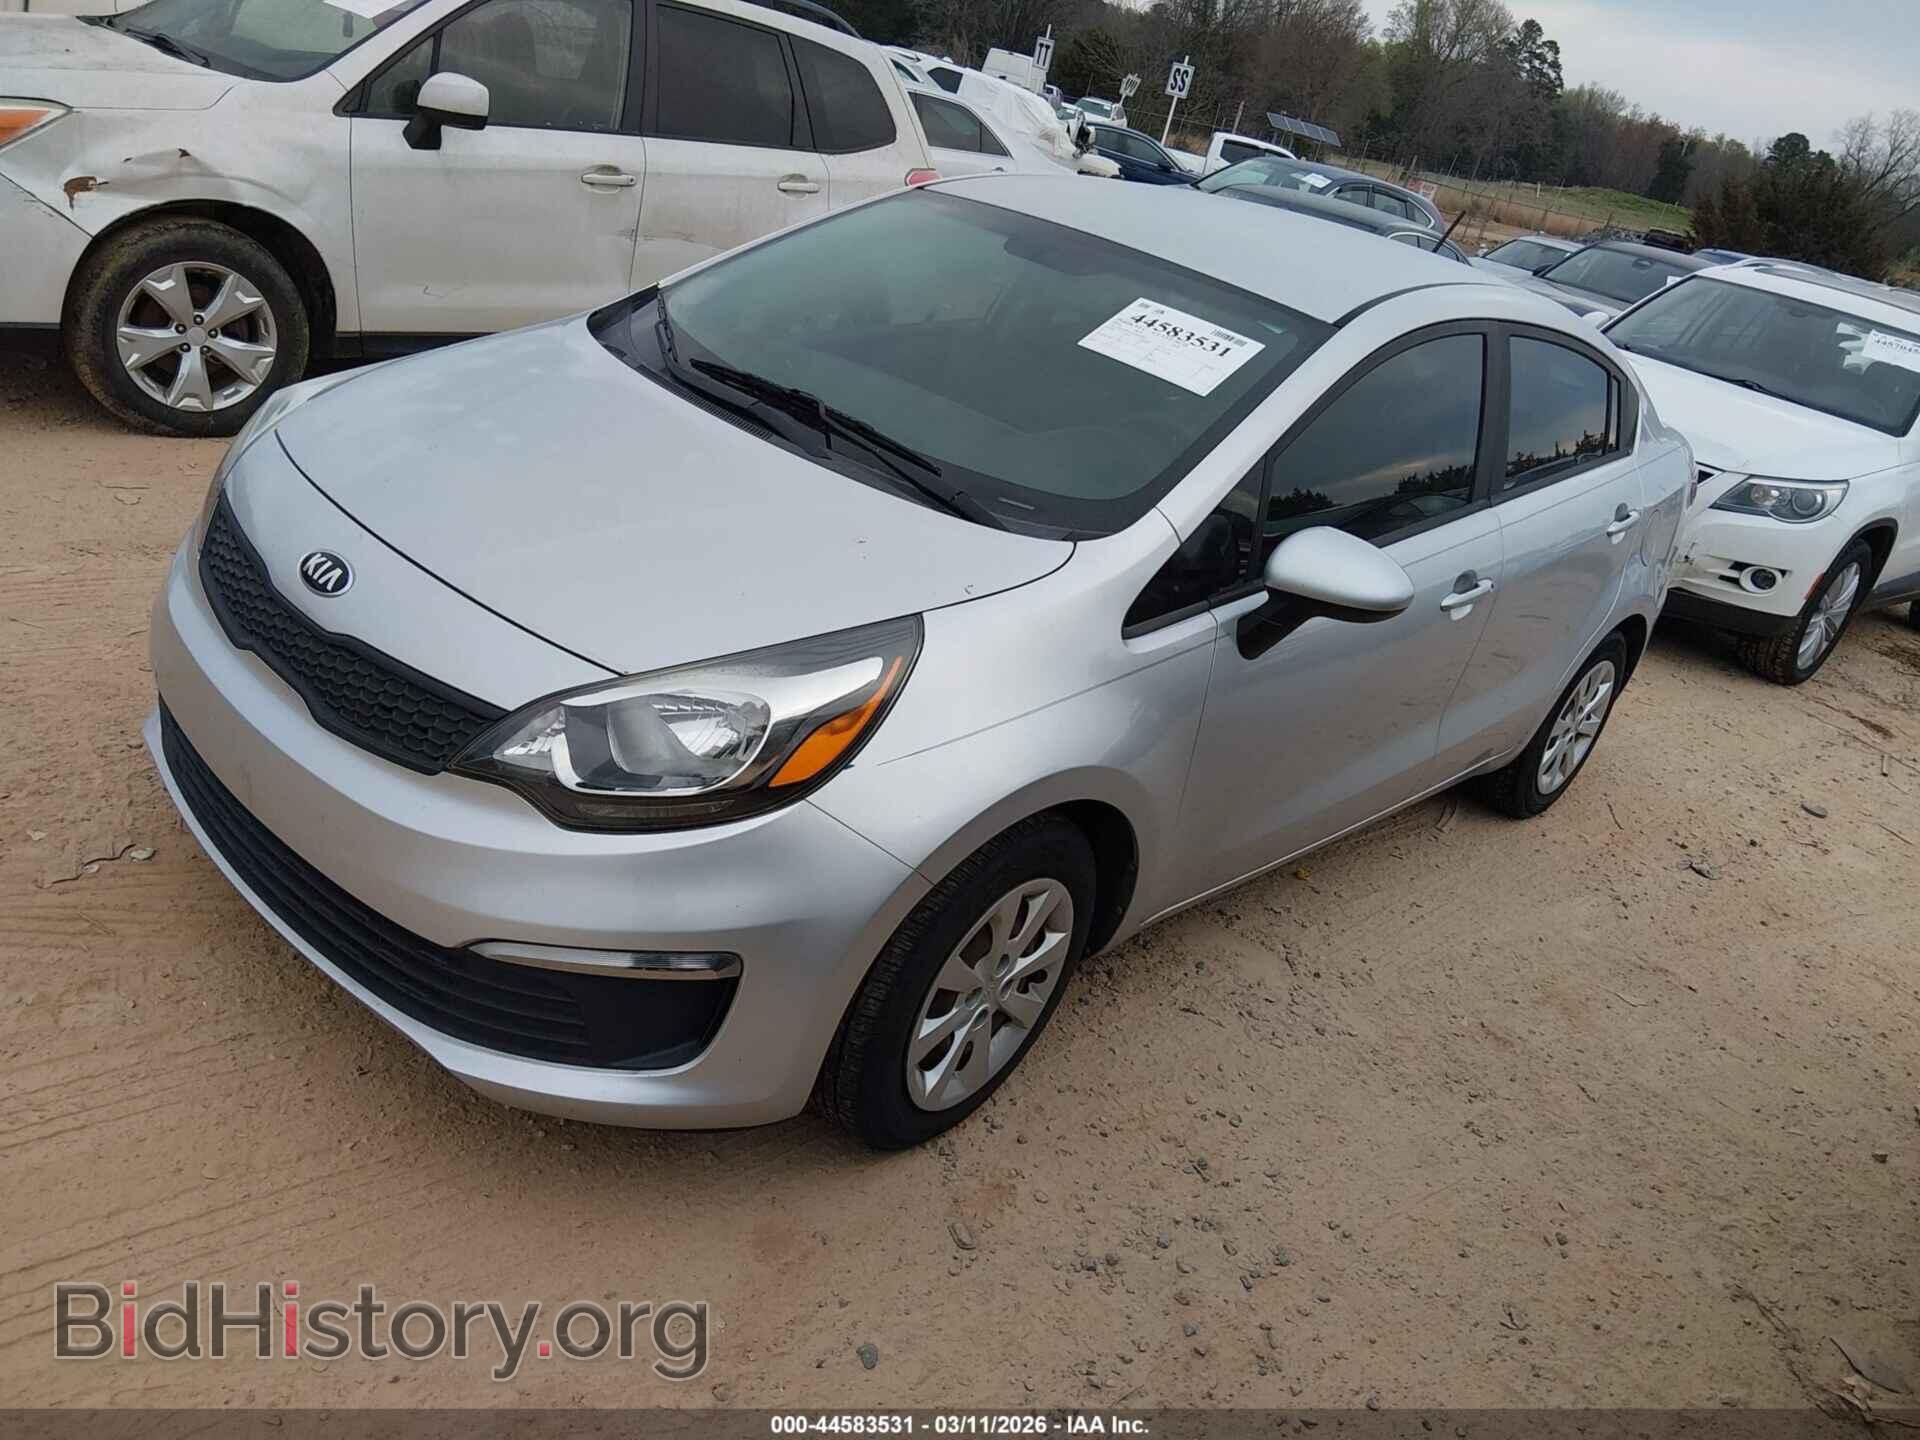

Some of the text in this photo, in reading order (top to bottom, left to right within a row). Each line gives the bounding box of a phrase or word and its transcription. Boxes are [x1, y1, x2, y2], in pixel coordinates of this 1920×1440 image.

[1036, 43, 1051, 67] TT
[1170, 67, 1189, 92] SS
[1130, 314, 1232, 357] 44583531
[302, 552, 344, 592] KIA
